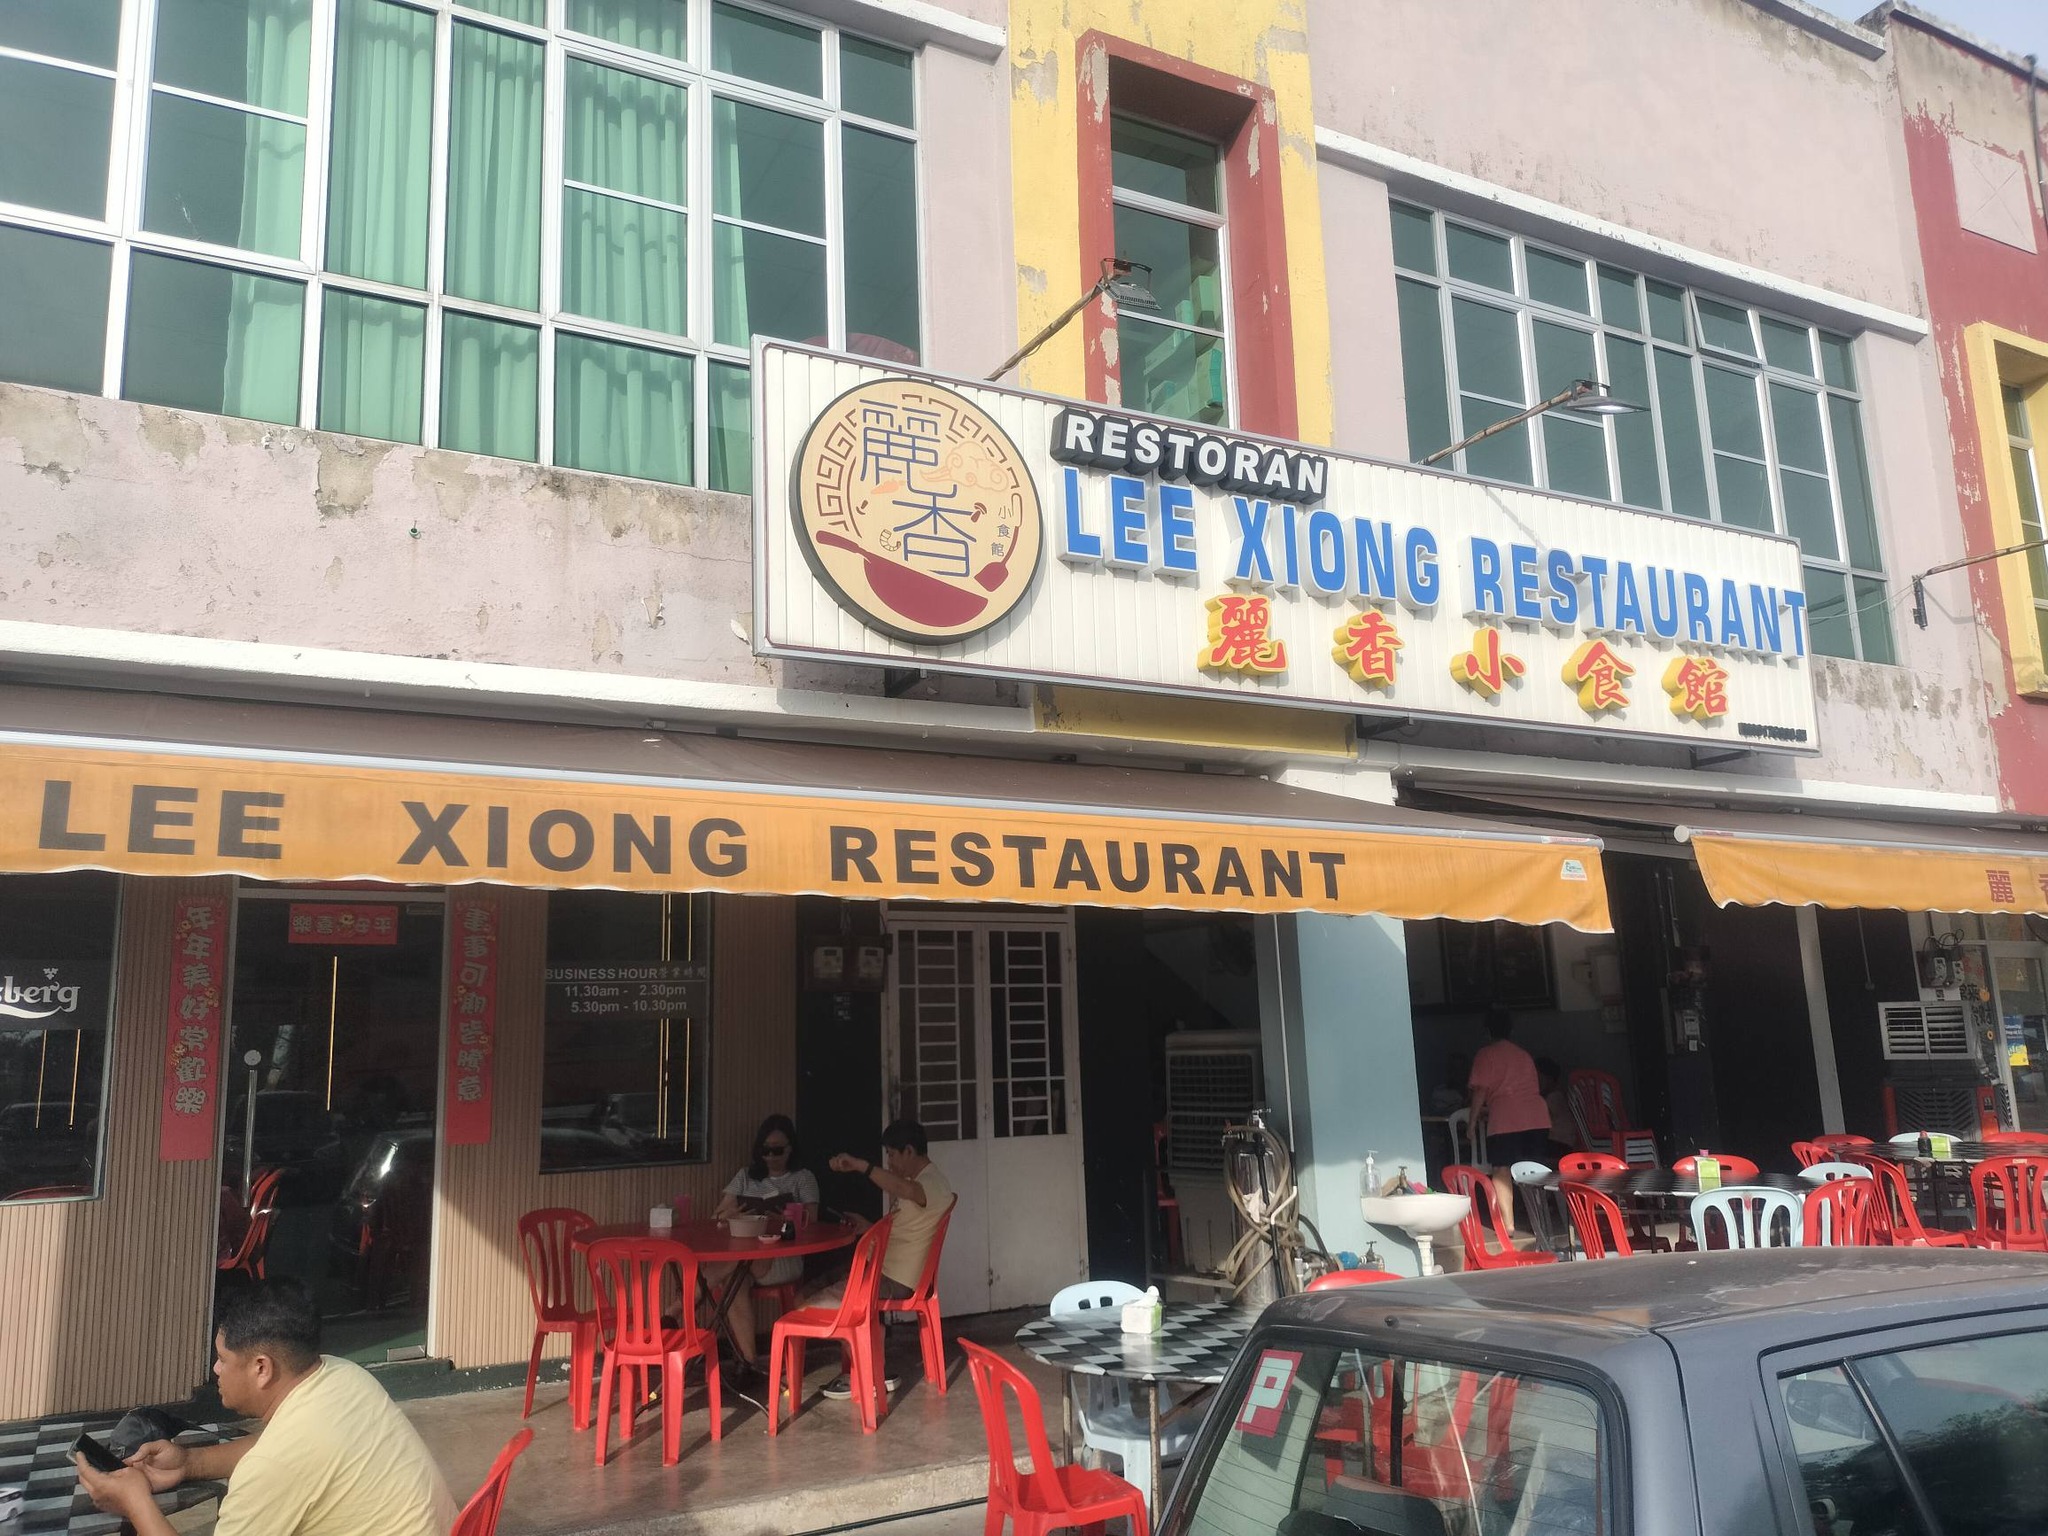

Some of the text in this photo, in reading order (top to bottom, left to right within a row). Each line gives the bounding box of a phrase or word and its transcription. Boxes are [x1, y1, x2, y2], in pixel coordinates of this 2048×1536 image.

[1065, 414, 1324, 494] RESTORAN
[1064, 468, 1806, 657] LEE XIONG RESTAURANT
[1210, 596, 1728, 722] 麗香小食館
[38, 780, 1347, 902] LEE XIONG RESTAURANT
[546, 968, 658, 980] BUSINESS HOUR
[565, 985, 619, 997] 11.30am
[640, 984, 687, 998] 2.30pm
[571, 1001, 620, 1015] 5.30pm
[633, 1000, 687, 1013] 10.30pm
[1242, 1357, 1293, 1424] P
